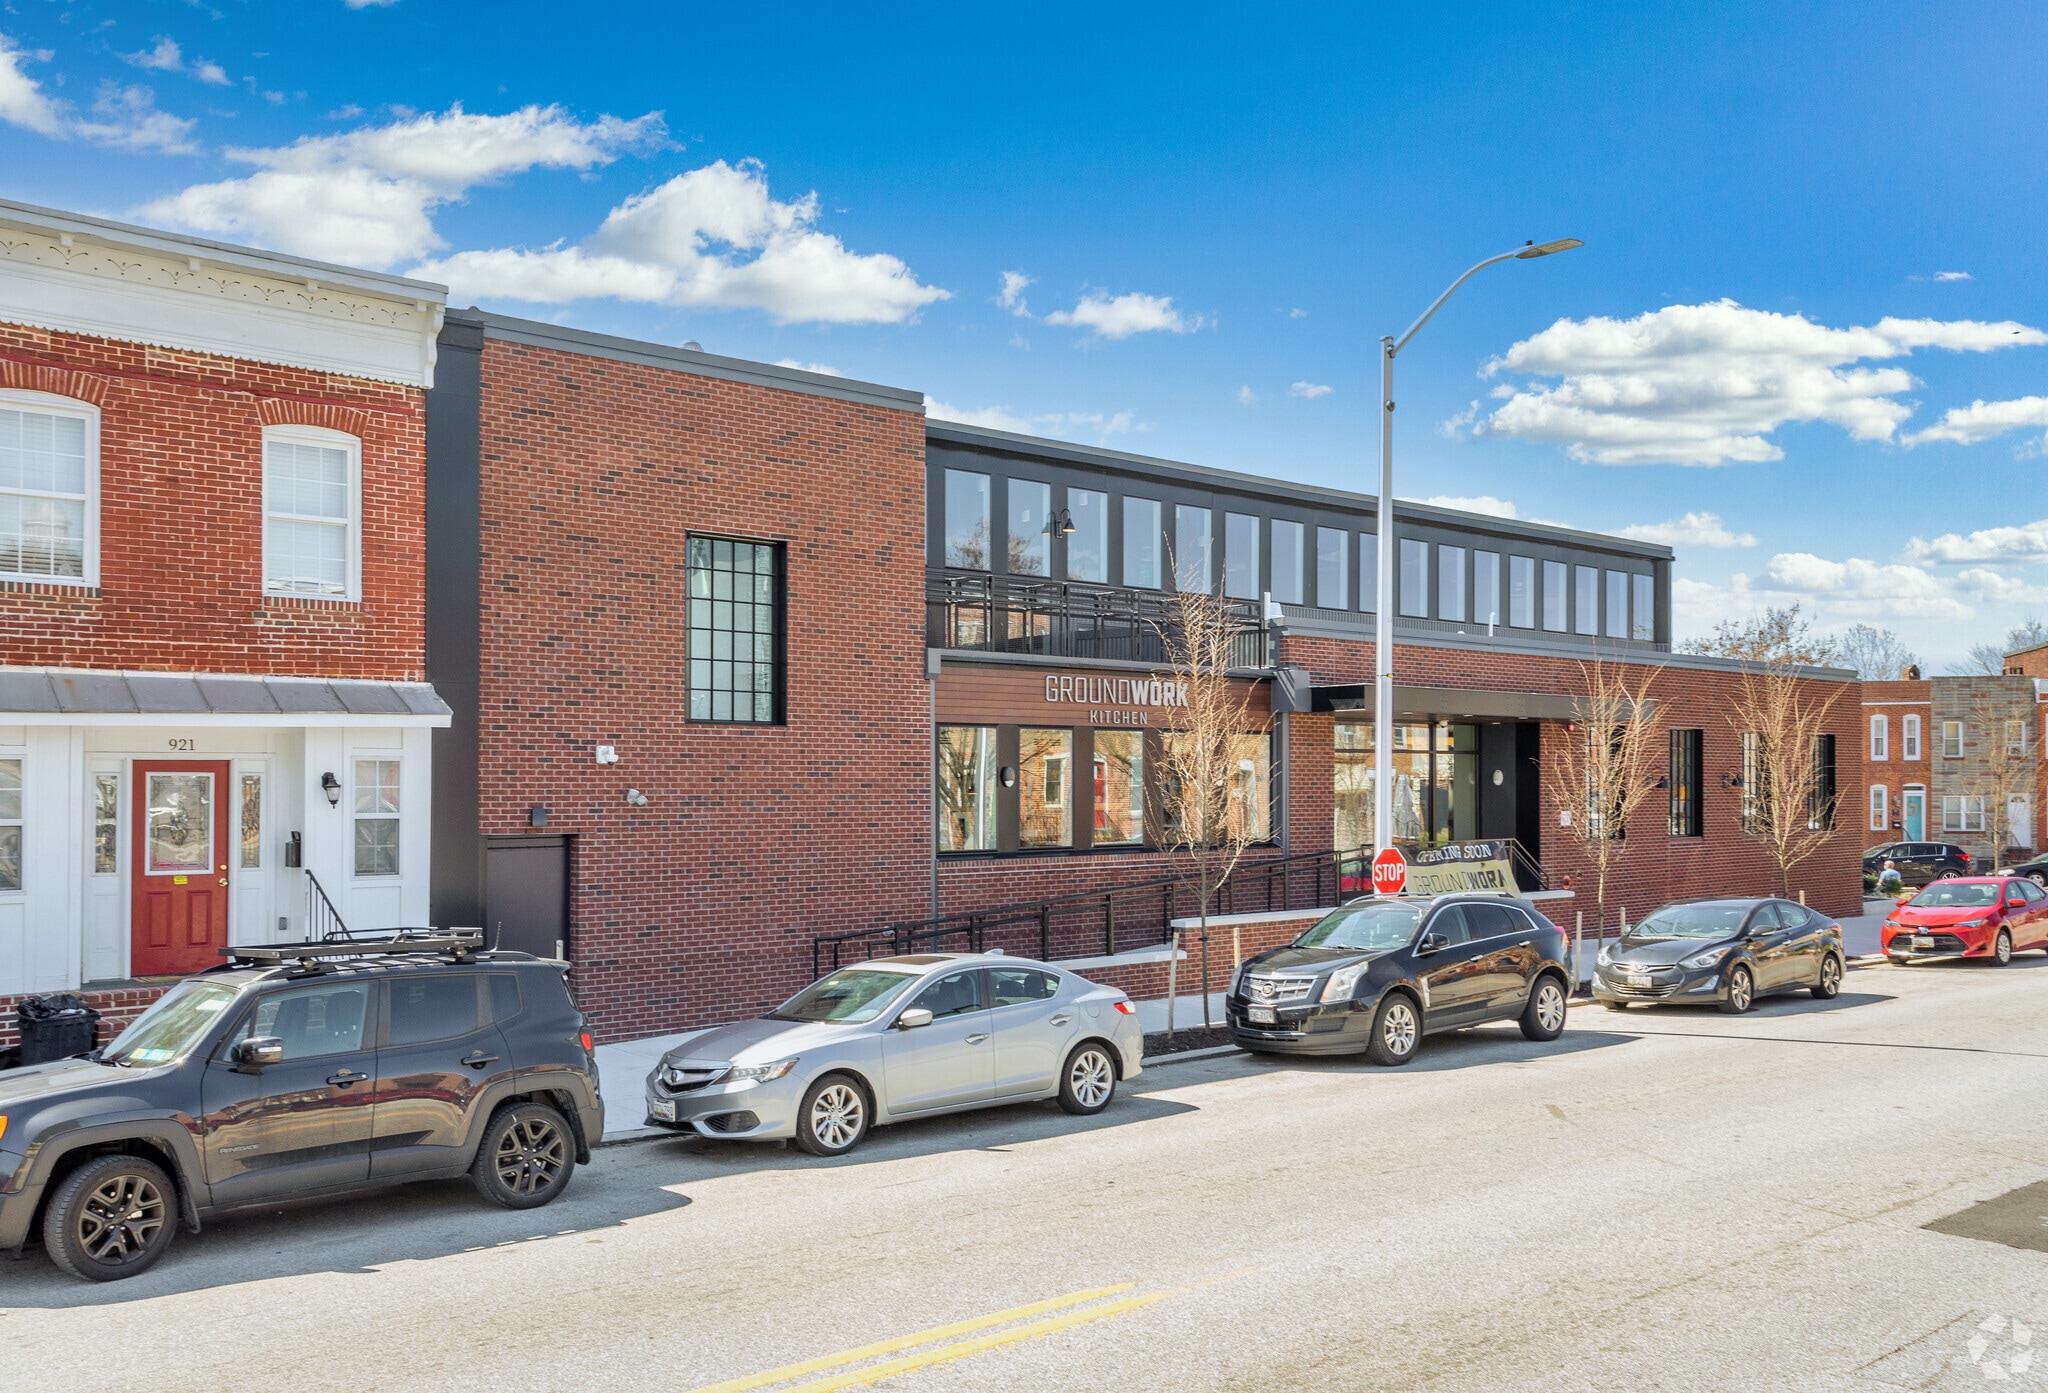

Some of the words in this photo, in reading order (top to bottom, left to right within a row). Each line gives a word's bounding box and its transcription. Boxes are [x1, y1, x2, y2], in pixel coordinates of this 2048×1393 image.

[1045, 675, 1188, 707] GROUNDWORK
[1089, 709, 1148, 725] KITCHEN
[168, 738, 195, 751] 921
[1416, 845, 1462, 863] OPENING
[1463, 844, 1492, 859] SOON
[1374, 863, 1404, 882] STOP
